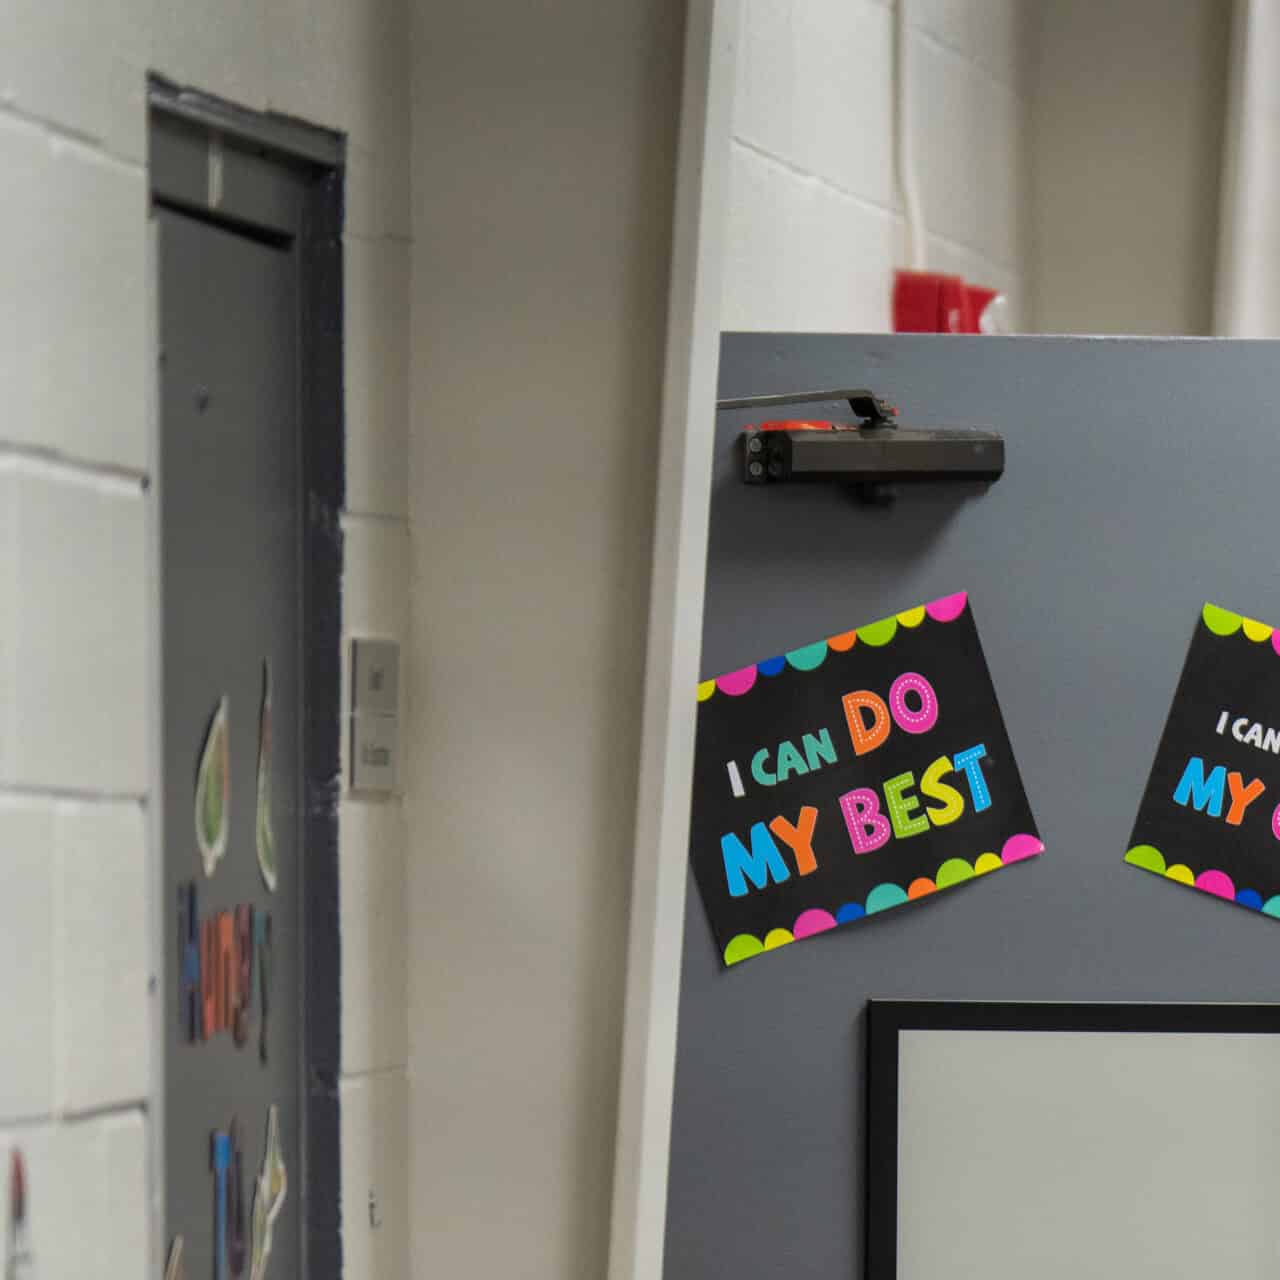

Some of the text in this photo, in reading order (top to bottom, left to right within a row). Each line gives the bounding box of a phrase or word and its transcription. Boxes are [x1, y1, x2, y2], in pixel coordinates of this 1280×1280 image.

[726, 671, 939, 798] I CAN DO
[1215, 711, 1231, 735] I
[720, 744, 992, 897] MY BEST
[1173, 757, 1266, 826] MY
